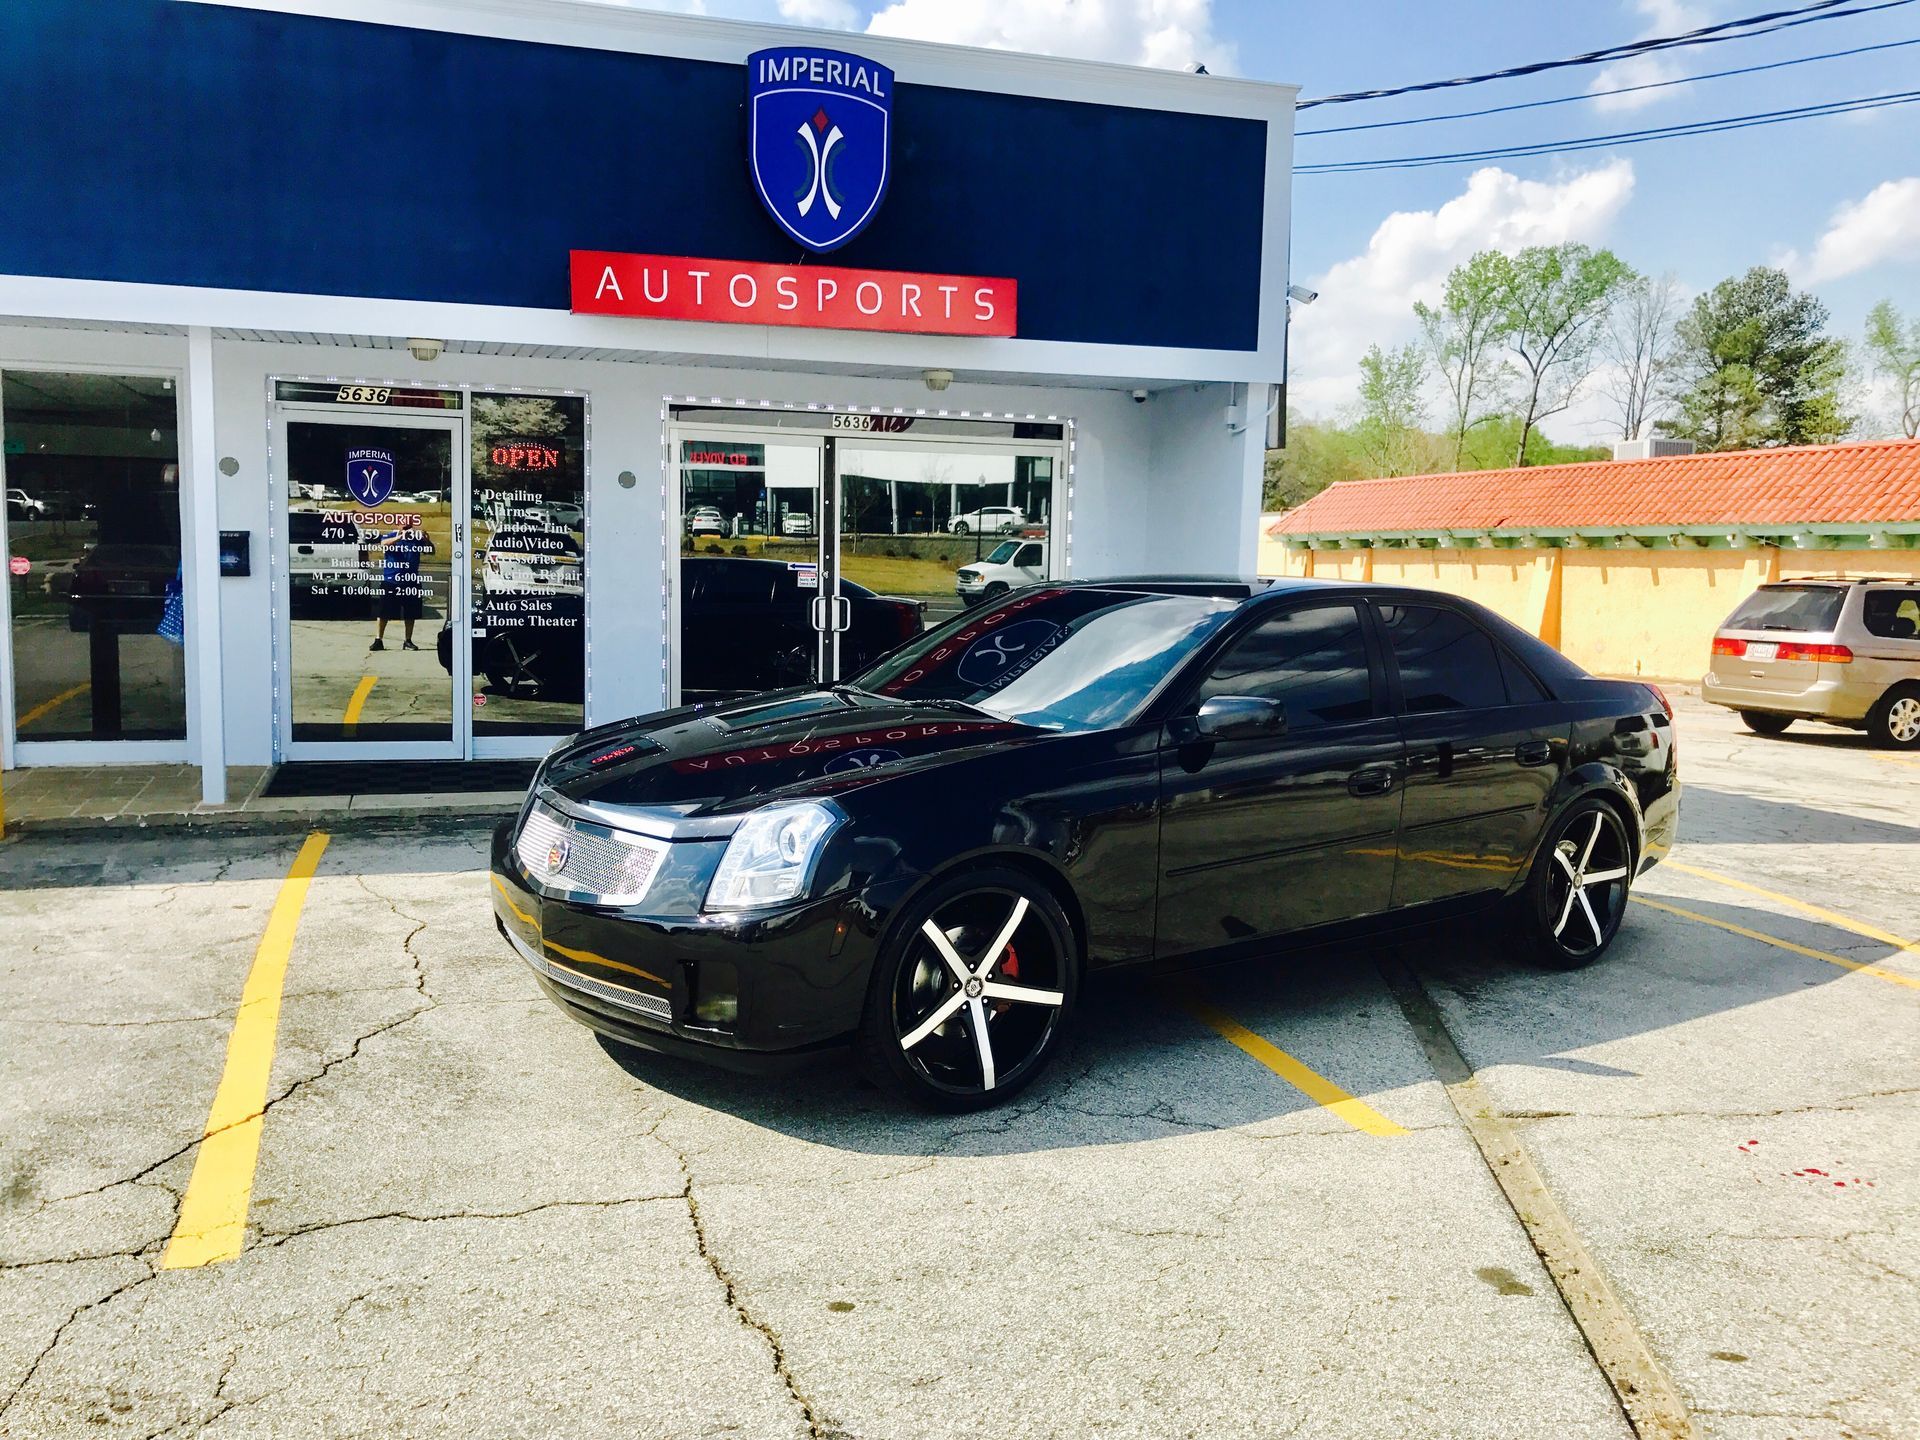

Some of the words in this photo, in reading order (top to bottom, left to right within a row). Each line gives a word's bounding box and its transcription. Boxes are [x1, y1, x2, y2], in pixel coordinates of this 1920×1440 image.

[759, 57, 885, 97] IMPERIAL
[595, 265, 995, 321] AUTOSPORTS
[339, 387, 388, 402] 5636
[834, 416, 869, 428] 5636
[349, 450, 392, 461] IMPERIAL
[492, 448, 559, 467] OPEN
[484, 489, 543, 504] Detailing
[484, 505, 531, 517] Alarms
[322, 511, 422, 525] AUTOSPORTS
[485, 519, 538, 533] Window
[542, 522, 569, 534] Tint
[321, 528, 345, 539] 470
[357, 528, 380, 540] 359
[395, 529, 423, 541] 7130
[484, 536, 564, 551] Audio\Video
[331, 559, 375, 569] Business
[378, 559, 410, 569] Hours
[312, 571, 323, 581] M
[334, 572, 342, 581] F
[346, 572, 385, 582] 9:00am
[394, 573, 433, 584] 6:00pm
[540, 569, 582, 583] Repair
[311, 585, 329, 595] Sat
[342, 586, 386, 596] 10:00am
[395, 587, 434, 597] 2:00pm
[520, 586, 556, 596] Dents
[485, 600, 517, 611] Auto
[520, 600, 553, 611] Sales
[486, 615, 525, 627] Home
[528, 616, 577, 627] Theater
